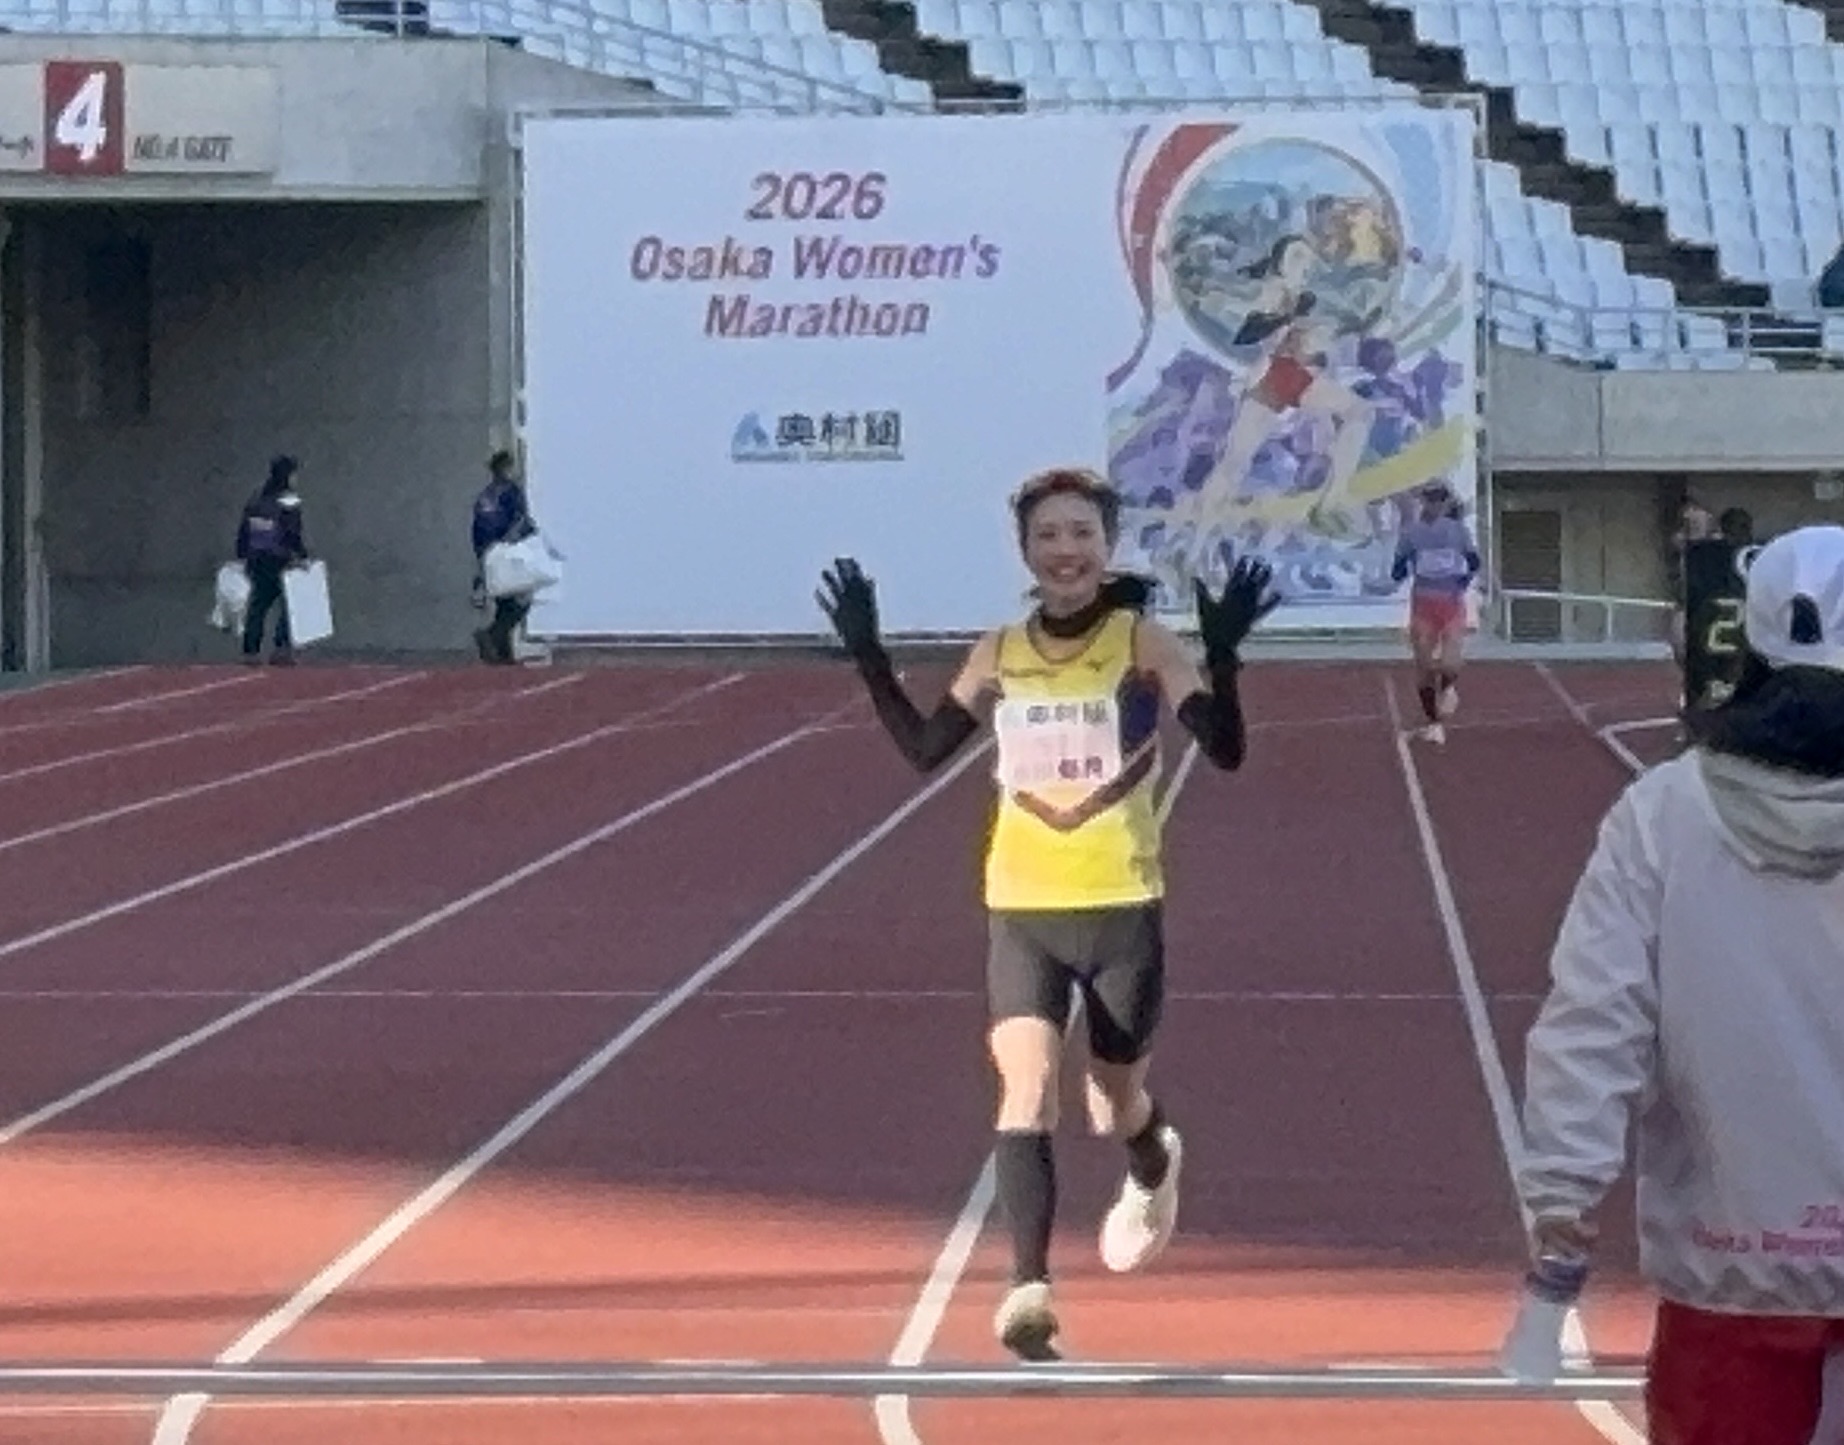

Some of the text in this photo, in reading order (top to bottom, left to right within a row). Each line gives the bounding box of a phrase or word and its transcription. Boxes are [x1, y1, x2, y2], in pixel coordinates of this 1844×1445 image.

[56, 71, 107, 161] 4
[745, 172, 887, 221] 2026
[629, 234, 1000, 281] Osaka Women's
[704, 294, 930, 338] Marathon
